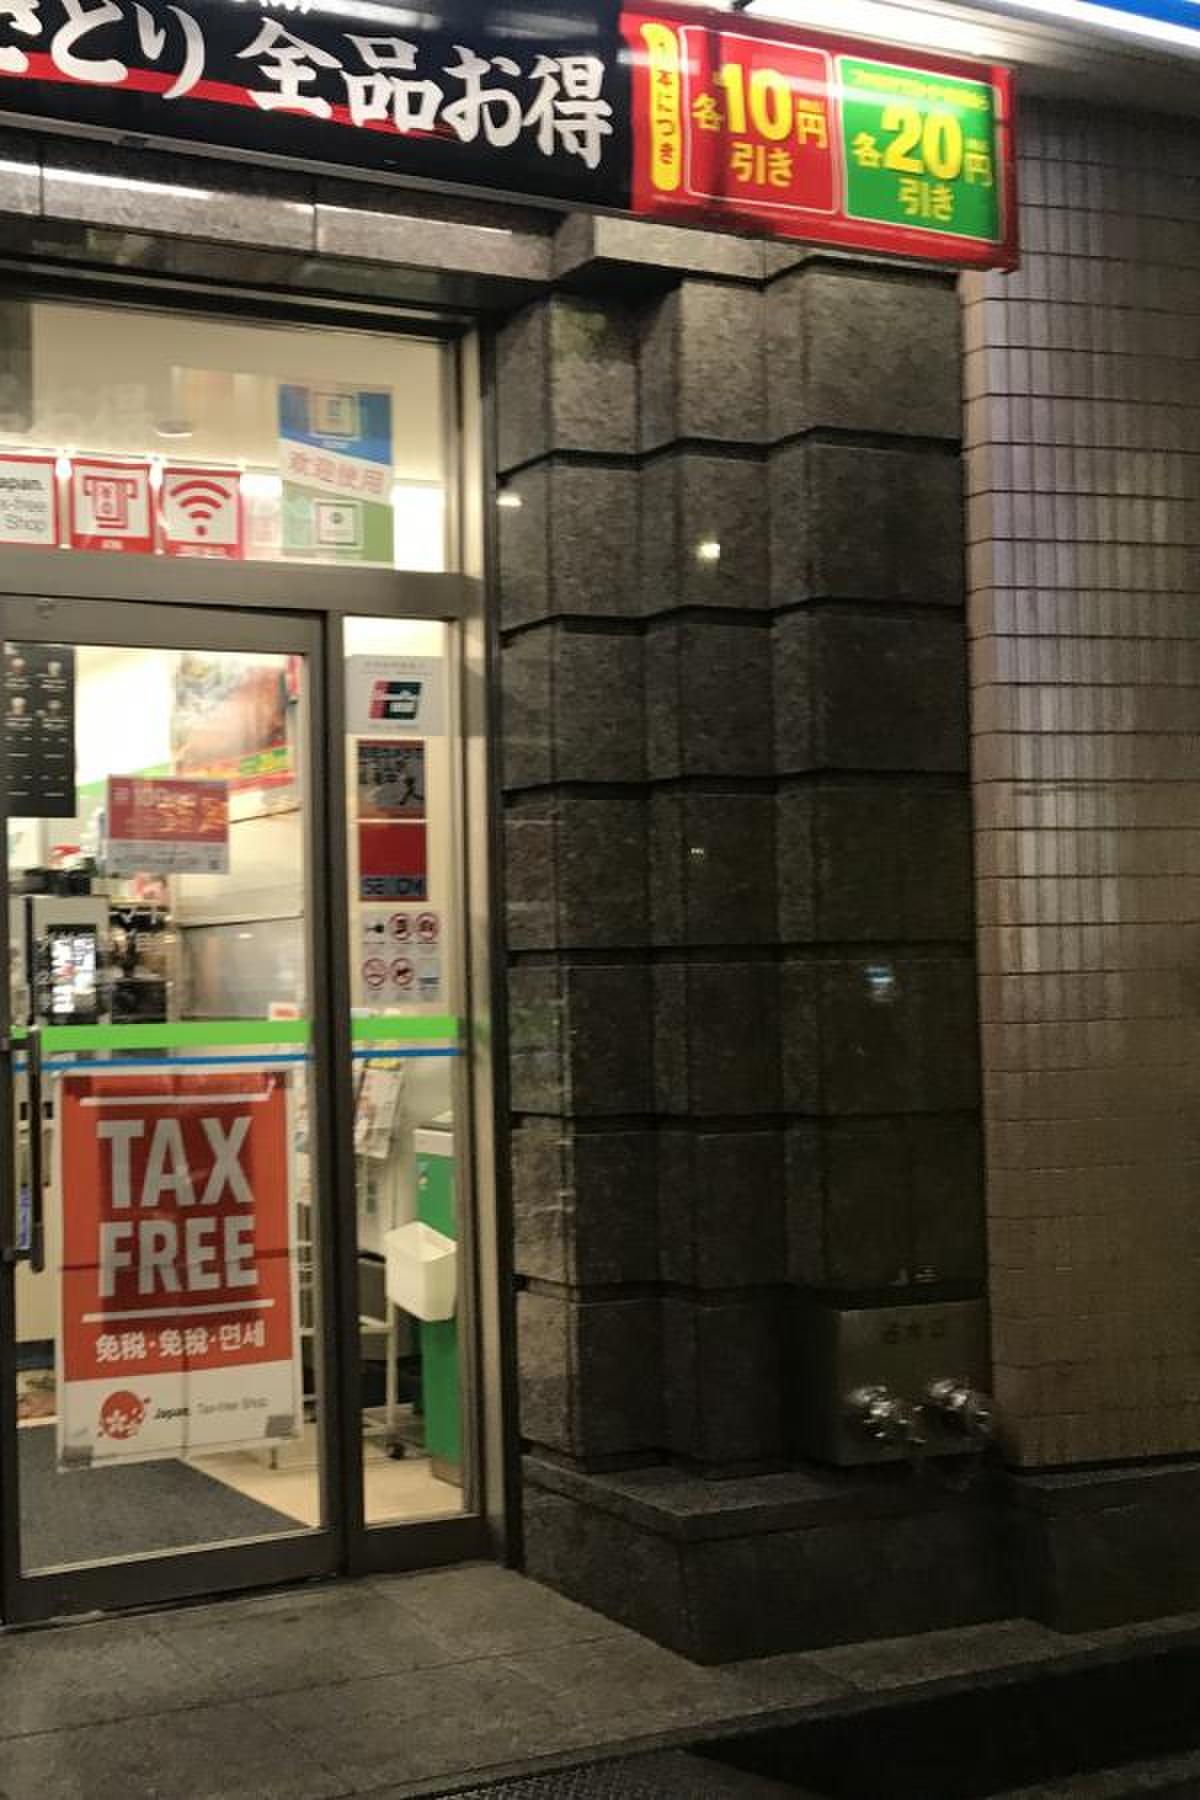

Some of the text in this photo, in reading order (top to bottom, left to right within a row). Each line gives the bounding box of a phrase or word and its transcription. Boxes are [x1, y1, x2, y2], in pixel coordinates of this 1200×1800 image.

[238, 16, 614, 169] 全品お得
[730, 141, 794, 188] 引き
[898, 177, 955, 222] 引き
[96, 1115, 256, 1210] TAX
[98, 1214, 259, 1298] FREE
